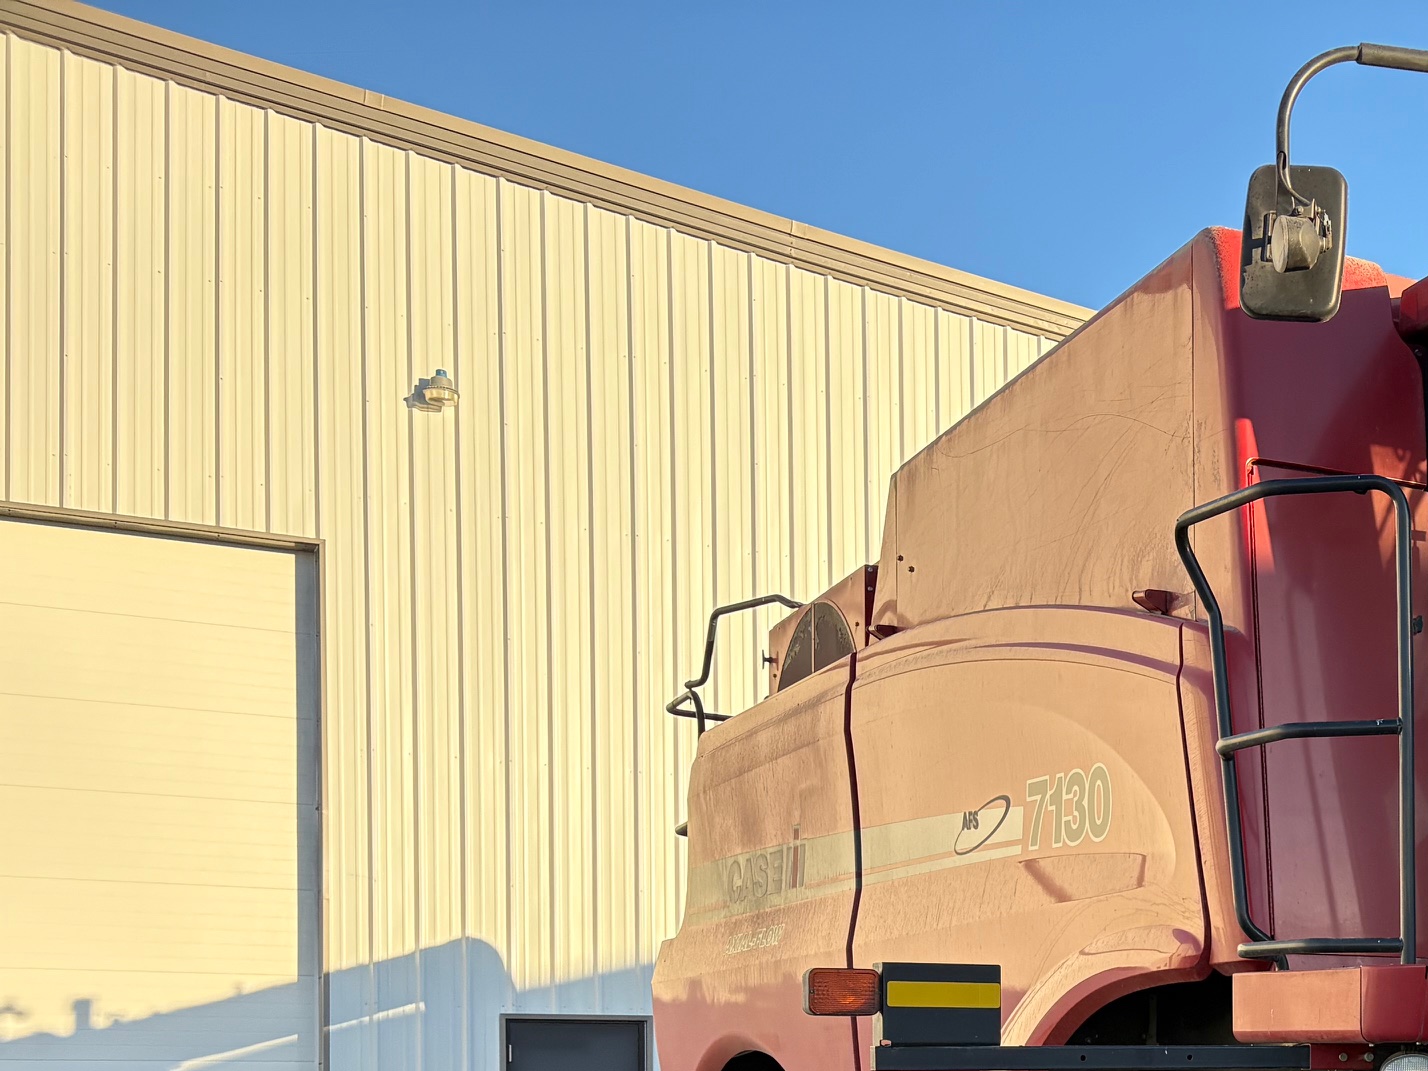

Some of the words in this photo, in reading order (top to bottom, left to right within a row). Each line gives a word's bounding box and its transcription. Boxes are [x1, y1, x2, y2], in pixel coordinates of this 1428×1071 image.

[962, 810, 980, 831] AFS
[1026, 762, 1112, 851] 7130
[728, 849, 783, 904] CASE
[724, 924, 785, 955] AXIAL-FLOW
